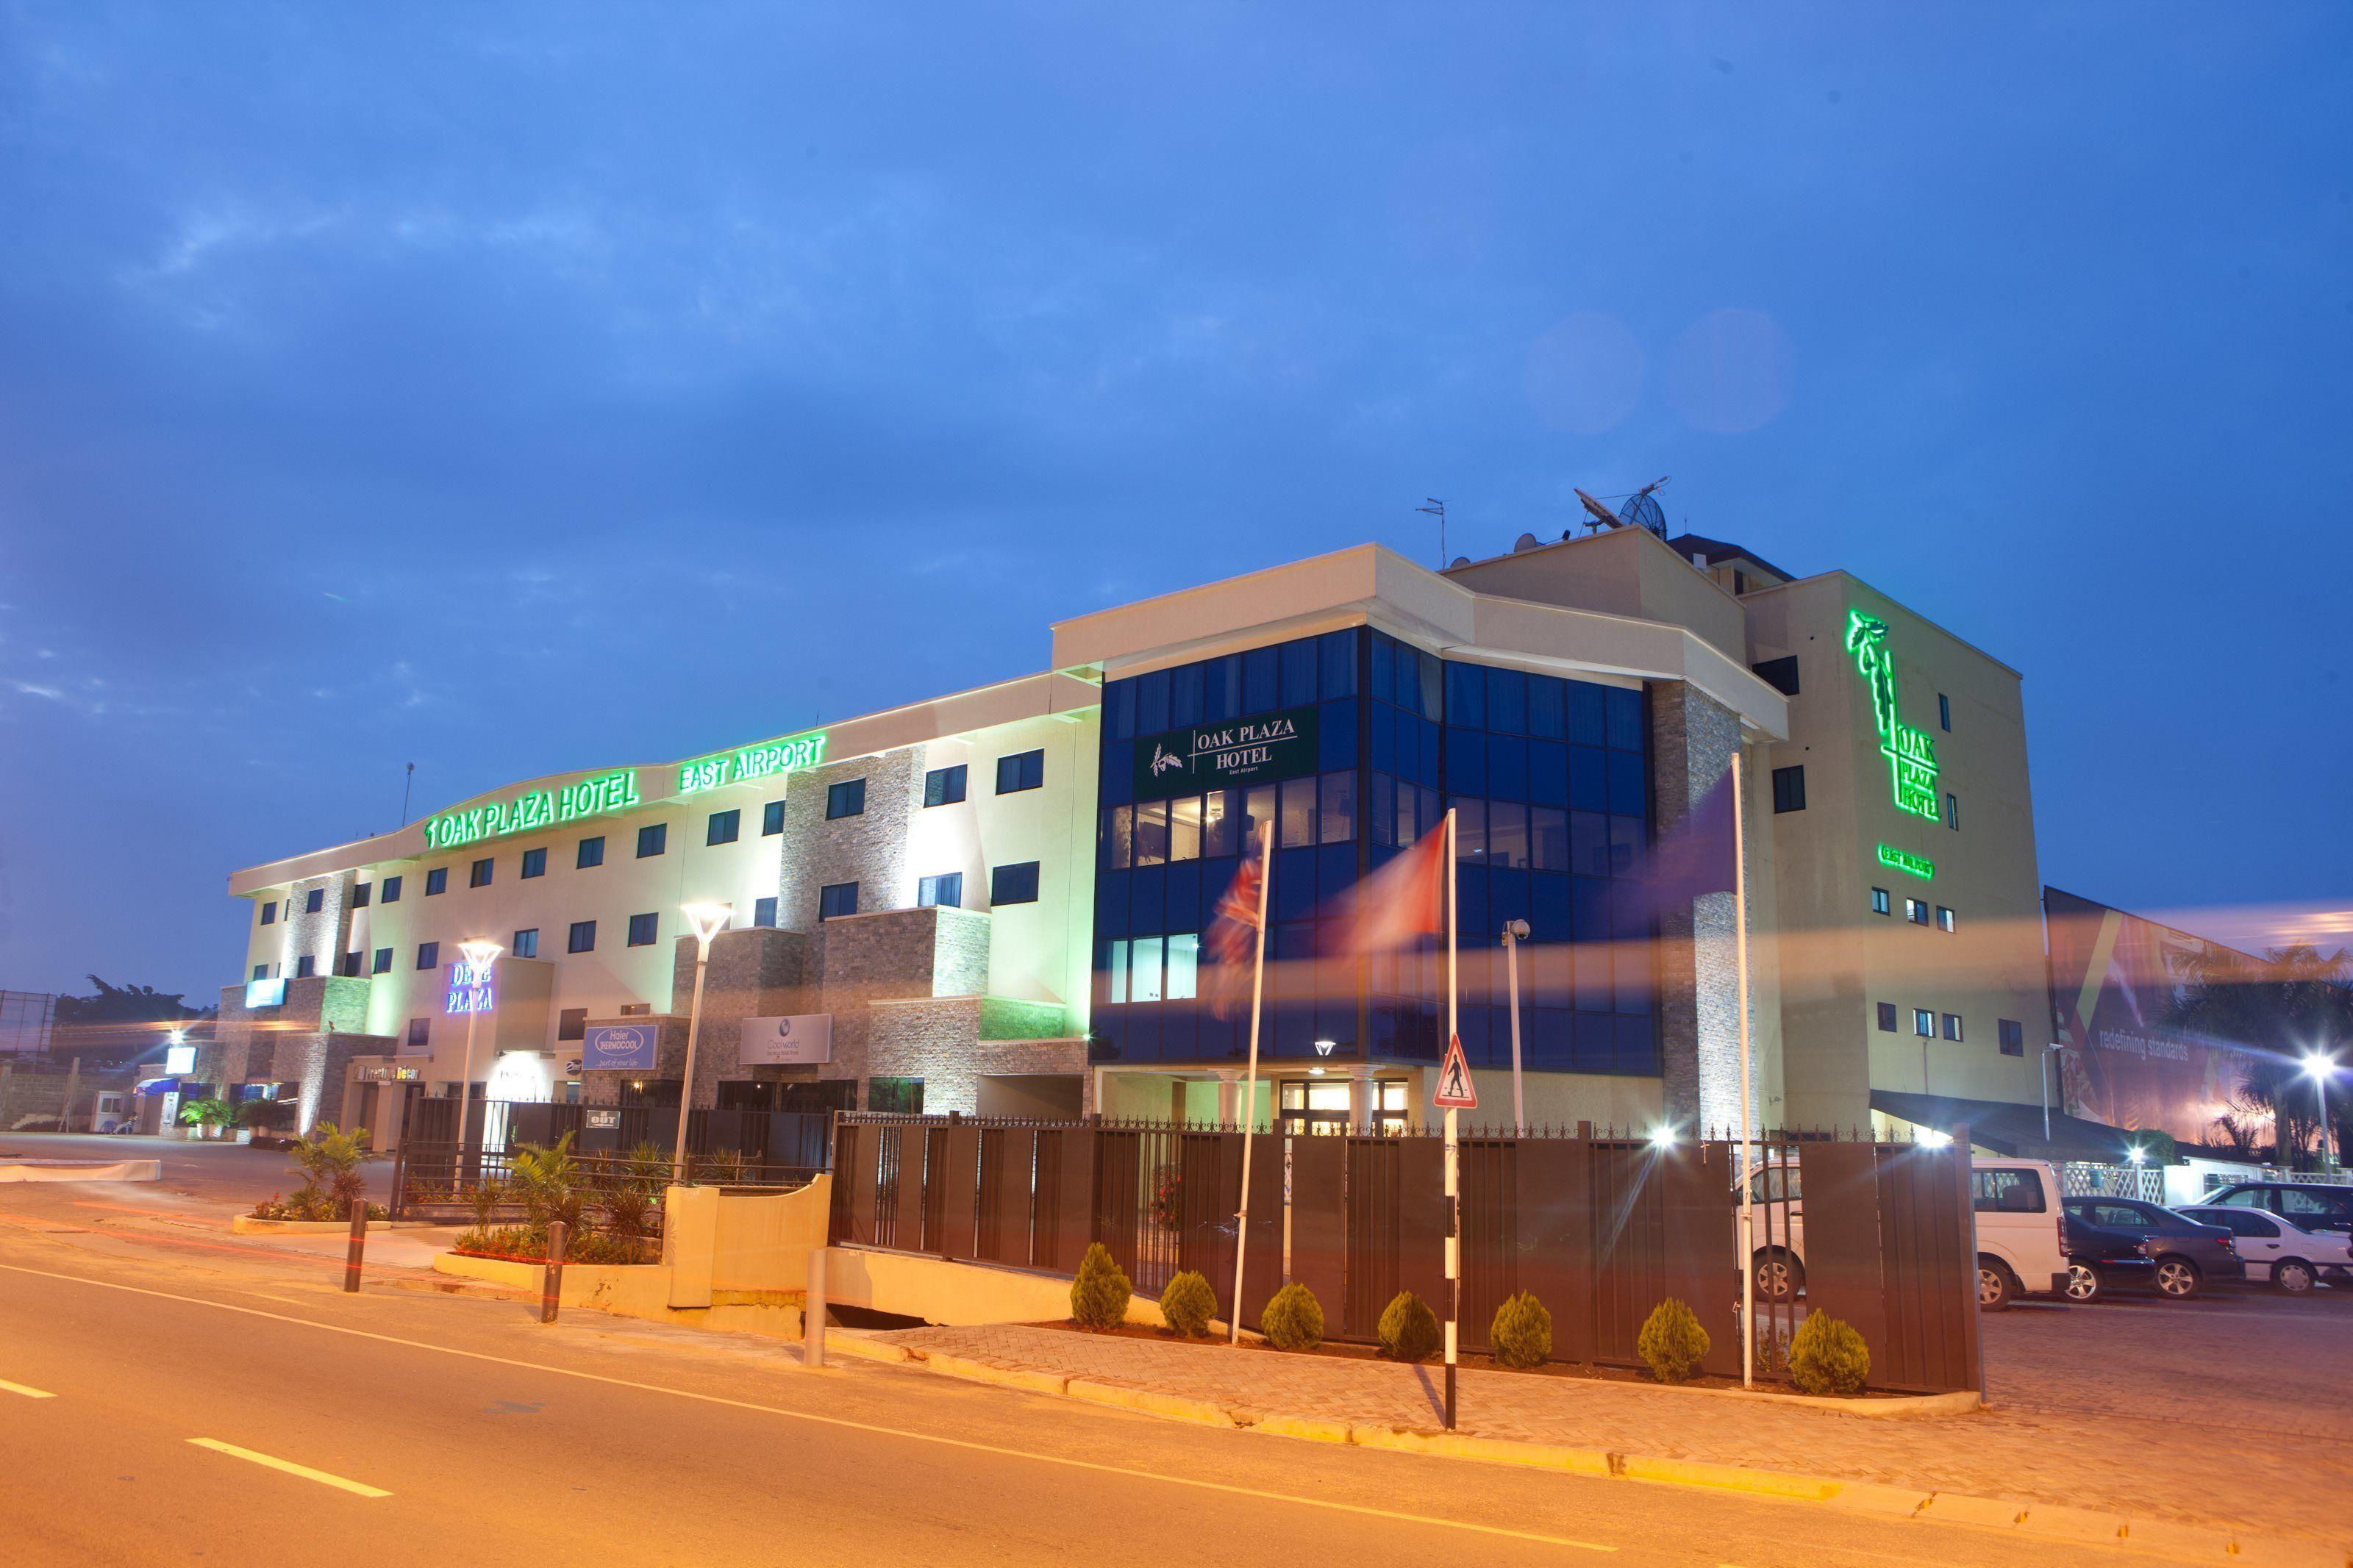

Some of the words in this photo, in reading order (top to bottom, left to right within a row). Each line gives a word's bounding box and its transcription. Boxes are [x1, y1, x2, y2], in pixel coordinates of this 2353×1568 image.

[1198, 729, 1234, 750] OAK
[1239, 718, 1296, 742] PLAZA
[1898, 726, 1935, 765] OAK
[680, 760, 729, 793] EAST
[733, 735, 826, 781] AIRPORT
[1216, 746, 1272, 770] HOTEL
[1240, 765, 1258, 774] Airport
[440, 809, 482, 847] OAK
[482, 792, 555, 837] PLAZA
[560, 772, 639, 820] HOTEL
[451, 963, 492, 986] DEE
[446, 988, 493, 1012] PLAZA
[600, 1040, 638, 1049] THERMOCOOL
[610, 1030, 629, 1039] Haier
[2099, 1028, 2146, 1060] redefining
[2147, 1037, 2188, 1061] standards
